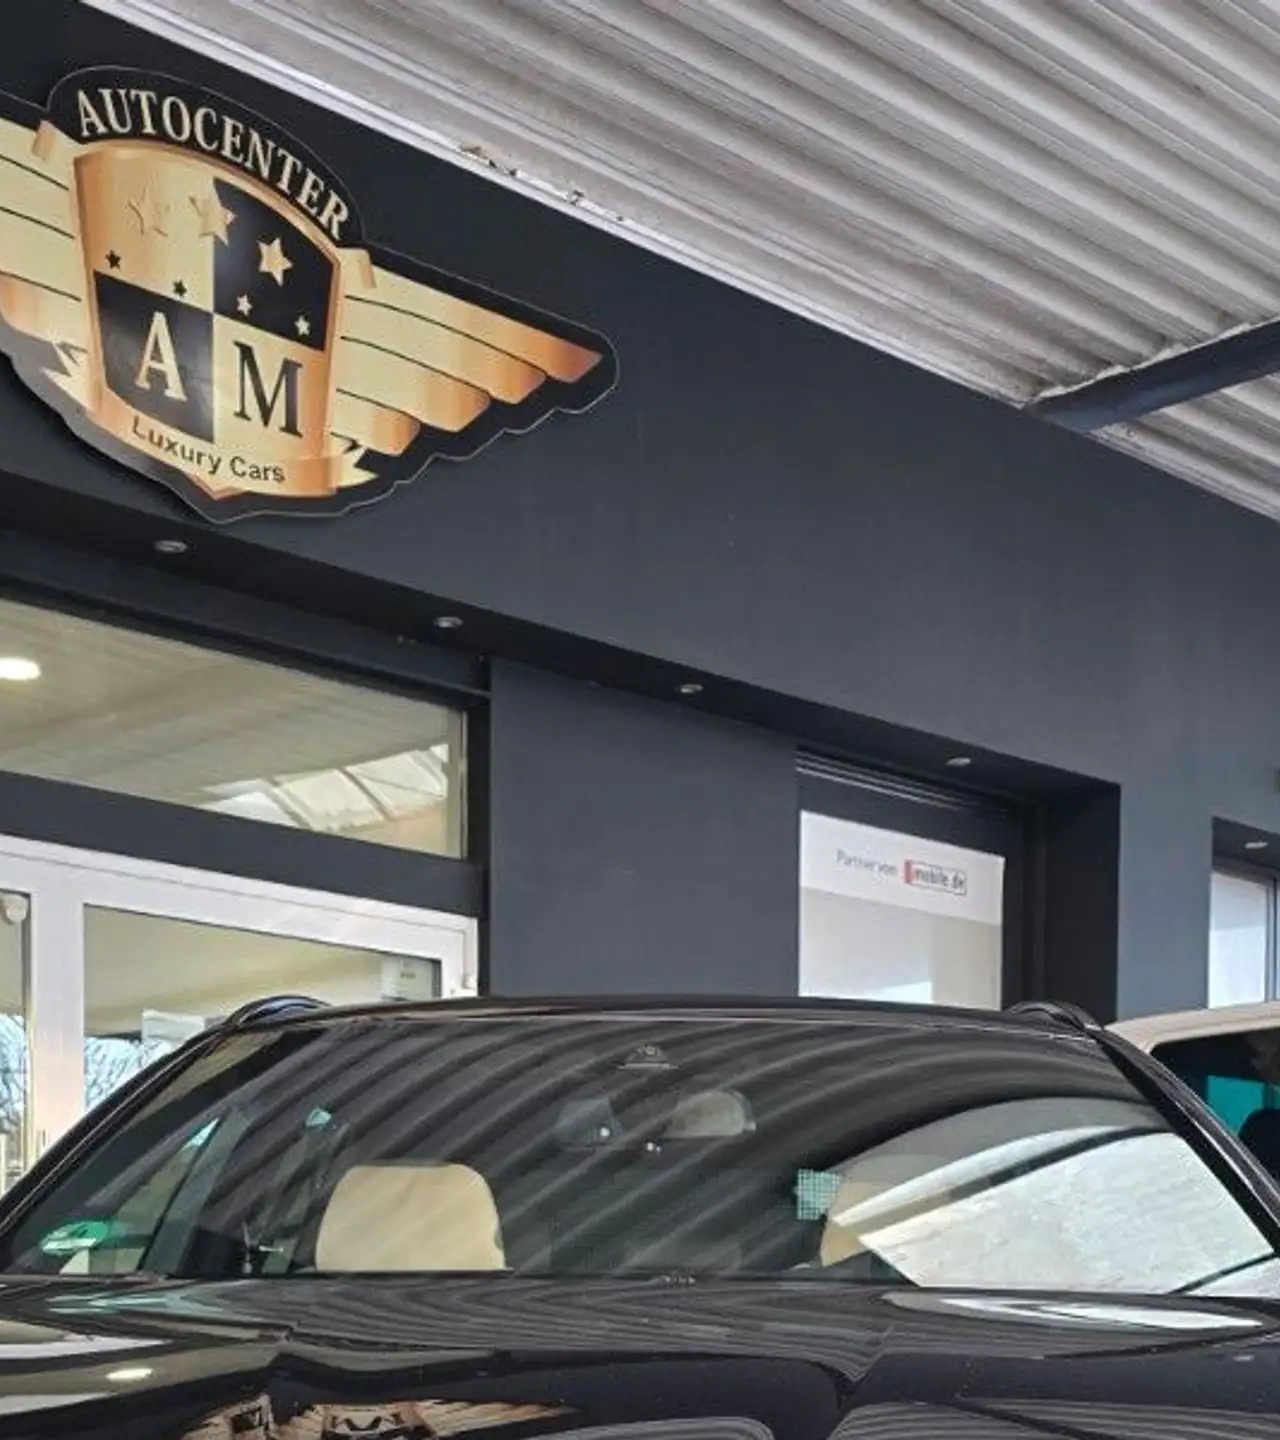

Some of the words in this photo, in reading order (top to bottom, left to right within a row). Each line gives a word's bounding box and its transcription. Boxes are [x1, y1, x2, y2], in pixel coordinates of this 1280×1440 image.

[77, 87, 349, 240] AUTOCENTER
[135, 311, 187, 401] A
[233, 340, 302, 438] M
[132, 415, 222, 475] Luxury
[229, 456, 286, 483] Cars
[836, 849, 874, 872] Partner
